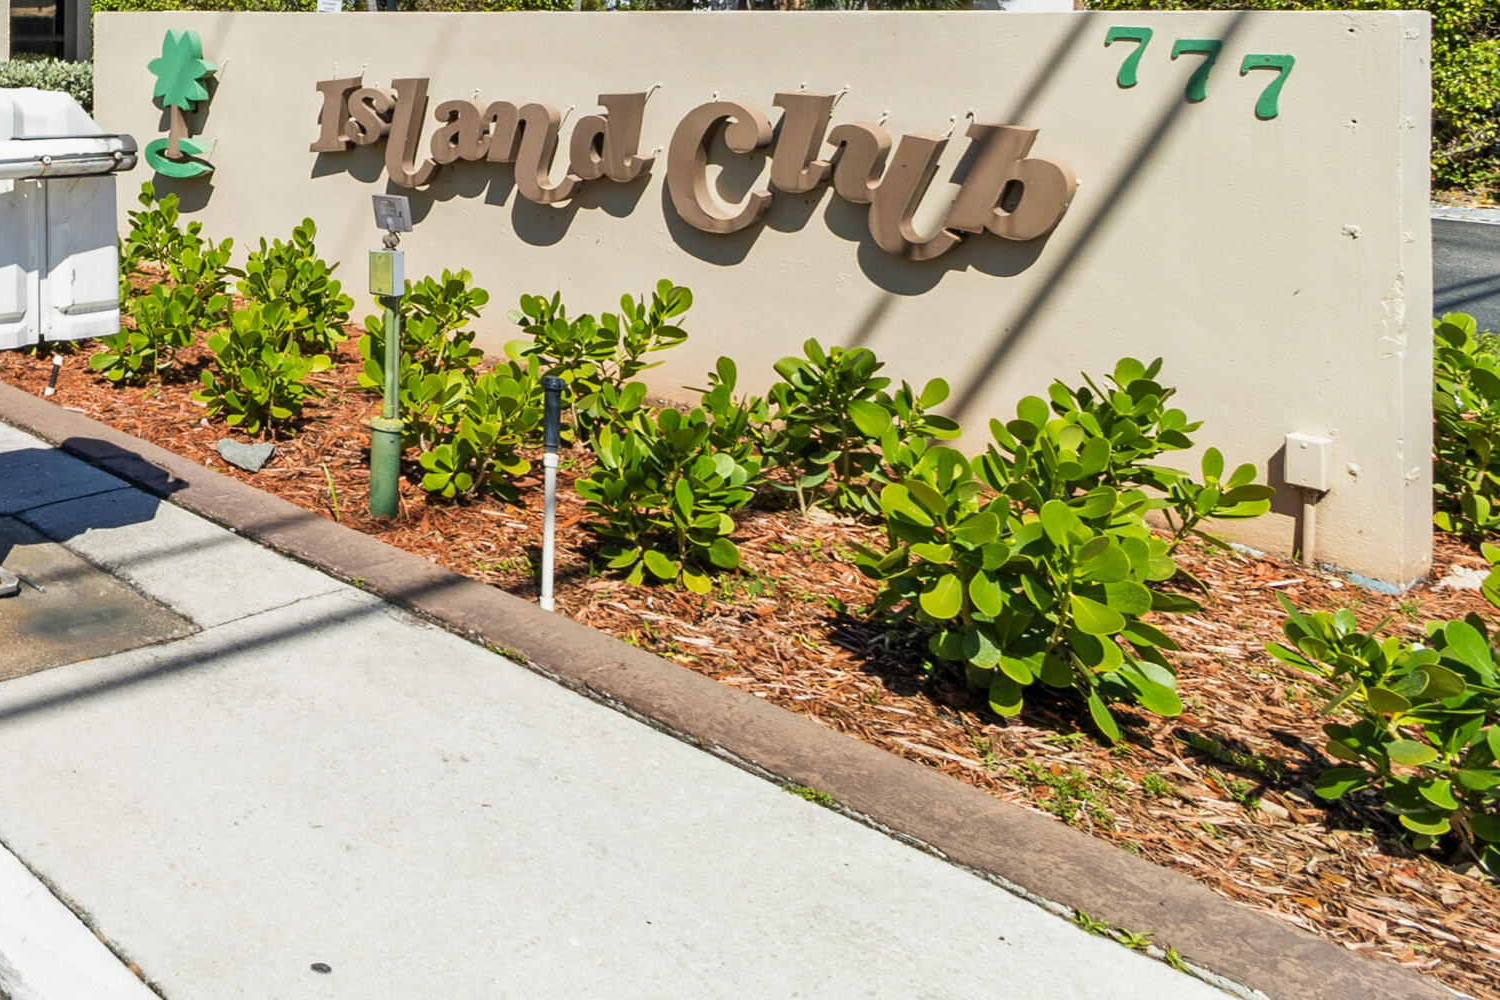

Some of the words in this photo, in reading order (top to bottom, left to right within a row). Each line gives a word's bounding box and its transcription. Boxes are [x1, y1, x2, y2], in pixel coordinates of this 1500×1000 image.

[1104, 26, 1295, 120] 777
[310, 77, 655, 204] Island
[667, 92, 1078, 261] Club
